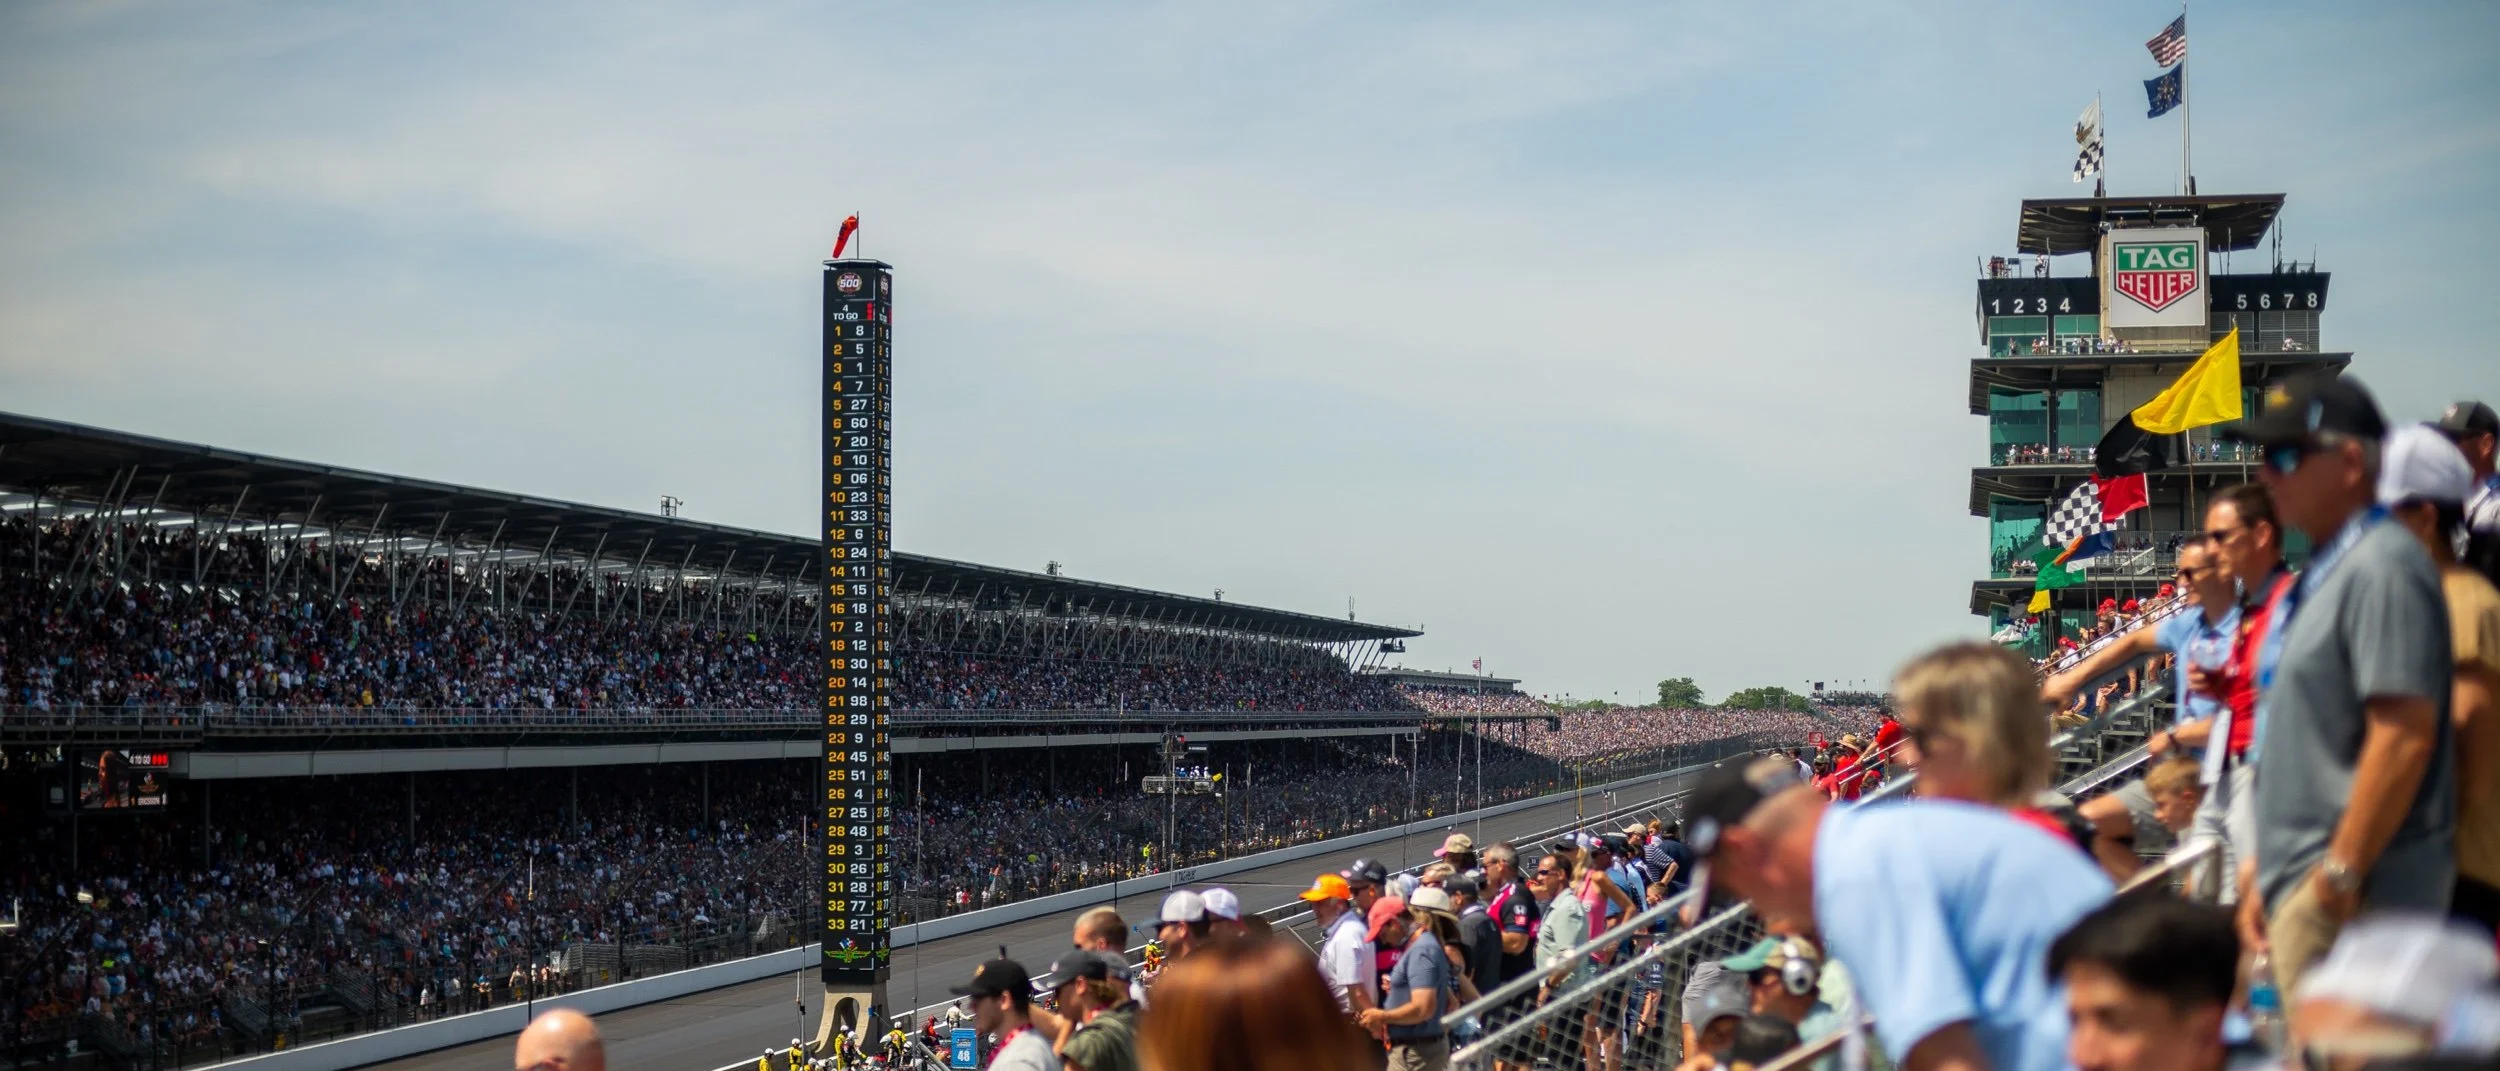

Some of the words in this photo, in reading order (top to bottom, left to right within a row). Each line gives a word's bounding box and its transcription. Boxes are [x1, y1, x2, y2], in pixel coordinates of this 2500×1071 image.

[2122, 247, 2189, 268] TAG
[840, 279, 859, 288] 500
[2121, 273, 2192, 305] HEUER
[1992, 299, 1999, 314] 1
[2013, 298, 2024, 314] 2
[2037, 298, 2047, 313] 3
[2060, 298, 2071, 313] 4
[2237, 294, 2247, 309] 5
[2260, 294, 2271, 309] 6
[2284, 293, 2294, 309] 7
[2307, 292, 2318, 308] 8
[842, 304, 849, 312] 4
[833, 312, 845, 320] TO
[846, 312, 858, 320] GO
[835, 326, 841, 336] 1
[856, 325, 864, 336] 8
[834, 344, 842, 355] 2
[856, 343, 864, 354] 5
[834, 363, 842, 373] 3
[857, 362, 862, 373] 1
[833, 381, 842, 392] 4
[855, 381, 863, 391] 7
[834, 400, 841, 410] 5
[851, 399, 867, 410] 27
[833, 418, 841, 429] 6
[851, 418, 868, 428] 60
[833, 436, 841, 447] 7
[851, 436, 868, 447] 20
[833, 455, 842, 466] 8
[852, 455, 867, 465] 10
[833, 473, 841, 484] 9
[851, 473, 867, 484] 06
[830, 492, 845, 503] 10
[851, 492, 867, 502] 23
[831, 511, 844, 521] 11
[851, 510, 867, 521] 33
[830, 529, 845, 540] 12
[855, 529, 863, 539] 6
[830, 548, 845, 558] 13
[851, 547, 867, 558] 24
[830, 566, 845, 577] 14
[852, 566, 865, 576] 11
[830, 584, 845, 595] 15
[852, 584, 867, 595] 15
[830, 603, 845, 614] 16
[852, 603, 867, 614] 18
[830, 621, 844, 632] 17
[855, 621, 863, 632] 2
[830, 640, 845, 651] 18
[852, 640, 867, 651] 12
[830, 659, 845, 669] 19
[851, 658, 868, 669] 30
[829, 677, 846, 688] 20
[852, 677, 867, 688] 14
[829, 696, 844, 706] 21
[850, 696, 867, 706] 98
[829, 714, 845, 725] 22
[850, 714, 867, 725] 29
[829, 733, 845, 744] 23
[855, 733, 863, 743] 9
[829, 752, 845, 762] 24
[850, 751, 867, 762] 45
[829, 770, 845, 780] 25
[851, 770, 865, 781] 51
[829, 788, 845, 799] 26
[854, 789, 863, 799] 4
[829, 807, 844, 818] 27
[851, 807, 867, 818] 25
[828, 826, 845, 836] 28
[850, 826, 867, 837] 48
[828, 844, 845, 855] 29
[854, 845, 863, 855] 3
[828, 863, 845, 874] 30
[850, 863, 867, 874] 26
[828, 882, 843, 892] 31
[850, 882, 867, 893] 28
[828, 900, 845, 911] 32
[850, 900, 866, 911] 77
[828, 919, 845, 930] 33
[850, 919, 865, 930] 21
[957, 1050, 970, 1062] 48
